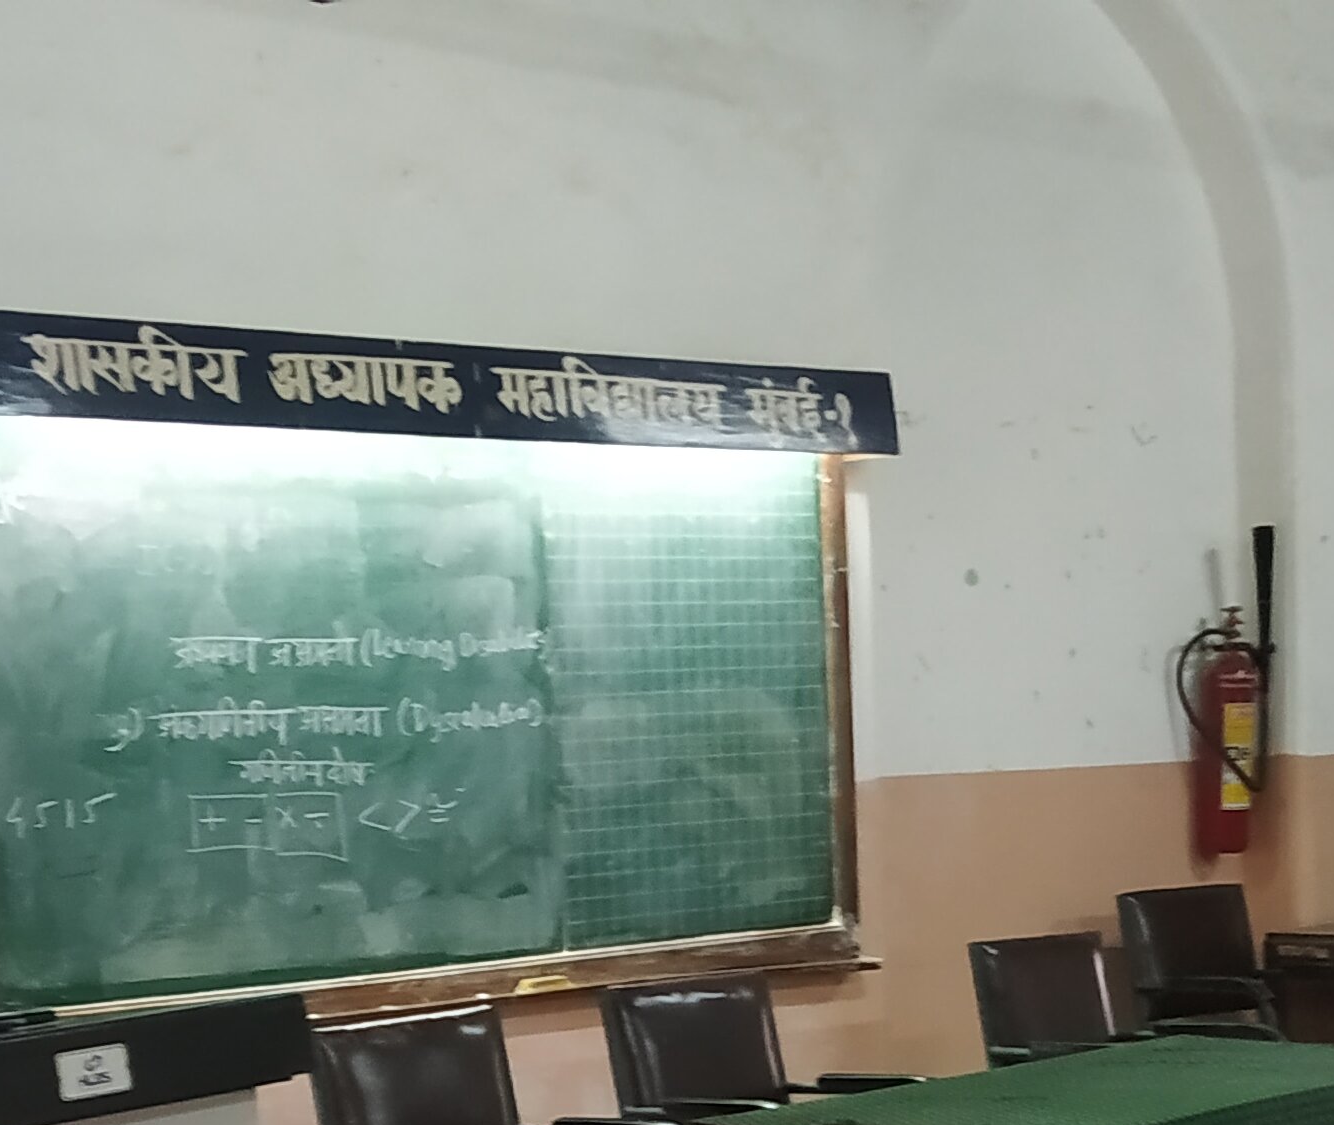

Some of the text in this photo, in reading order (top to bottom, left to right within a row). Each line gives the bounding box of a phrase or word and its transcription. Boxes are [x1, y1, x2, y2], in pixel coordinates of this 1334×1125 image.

[20, 325, 248, 404] शासकीय
[267, 353, 463, 414] अध्यापक
[489, 357, 727, 422] महाविद्यालय
